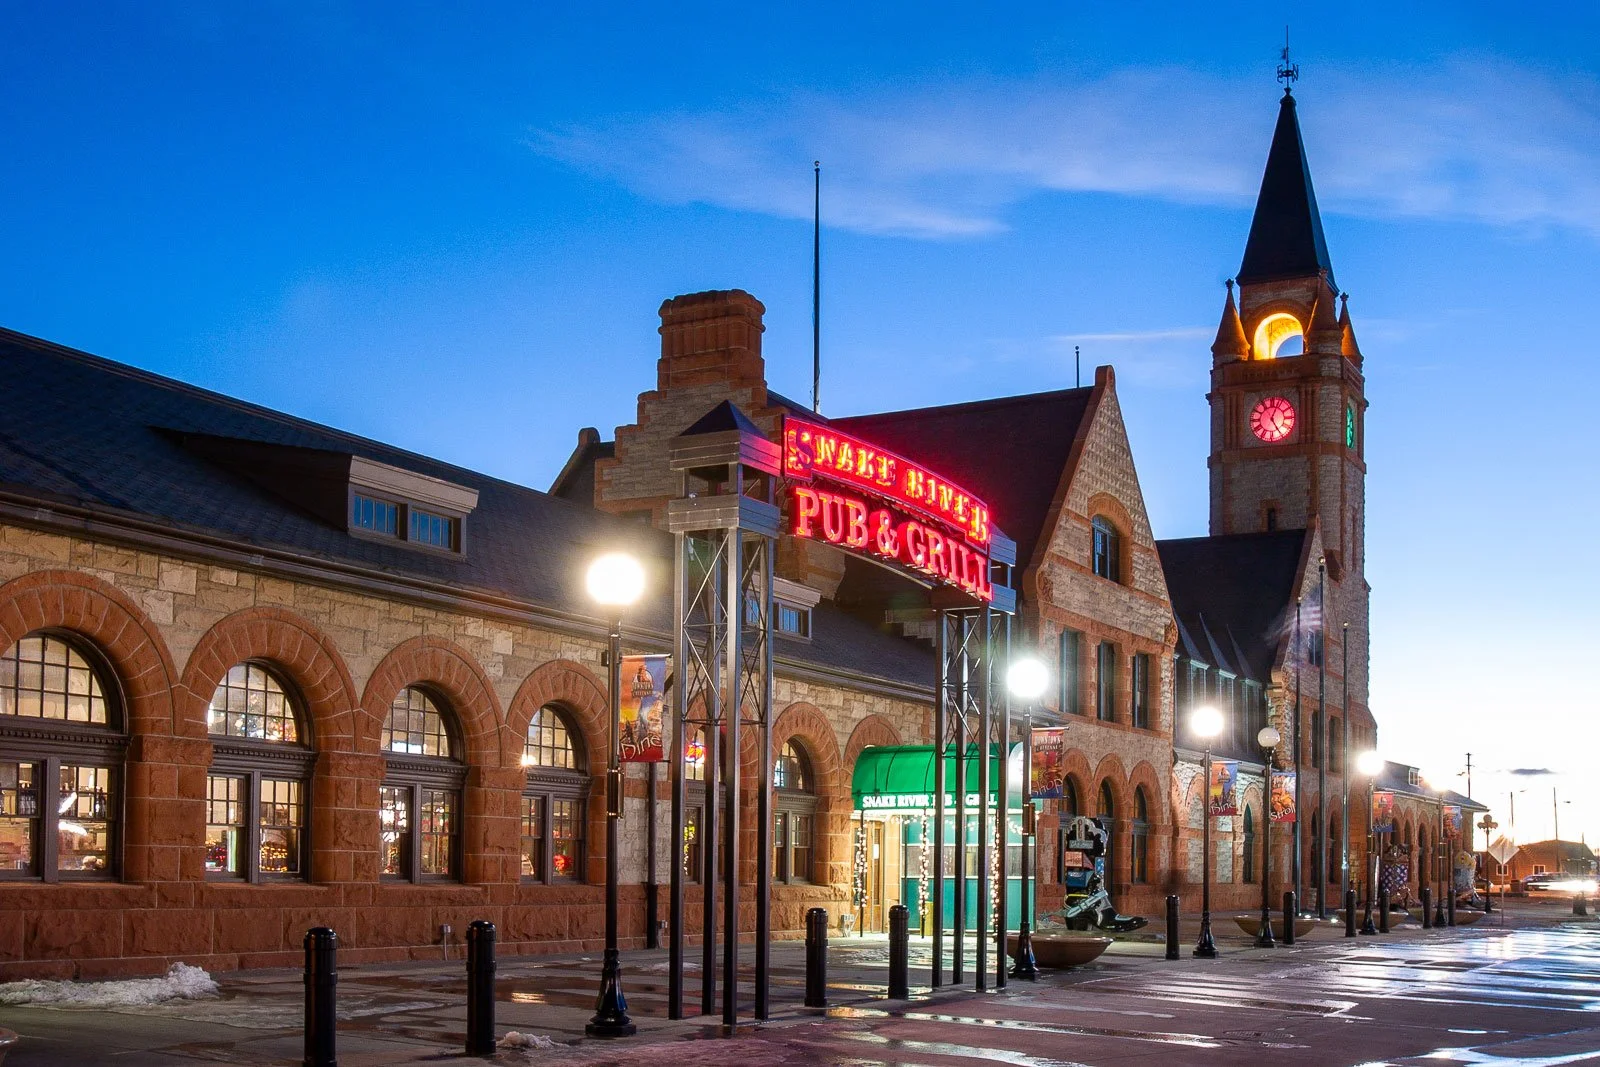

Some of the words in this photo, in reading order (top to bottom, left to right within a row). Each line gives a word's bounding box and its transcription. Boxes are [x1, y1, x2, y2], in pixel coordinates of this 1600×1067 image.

[787, 428, 896, 486] SNAKE
[905, 469, 990, 542] RIVER
[795, 487, 869, 548] PUB
[875, 509, 900, 558] &
[906, 521, 993, 601] GRILL
[620, 735, 662, 759] Dine
[863, 795, 897, 808] SNAKE
[897, 794, 930, 807] RIVER
[965, 794, 998, 806] GRL
[1270, 803, 1296, 821] Stroll
